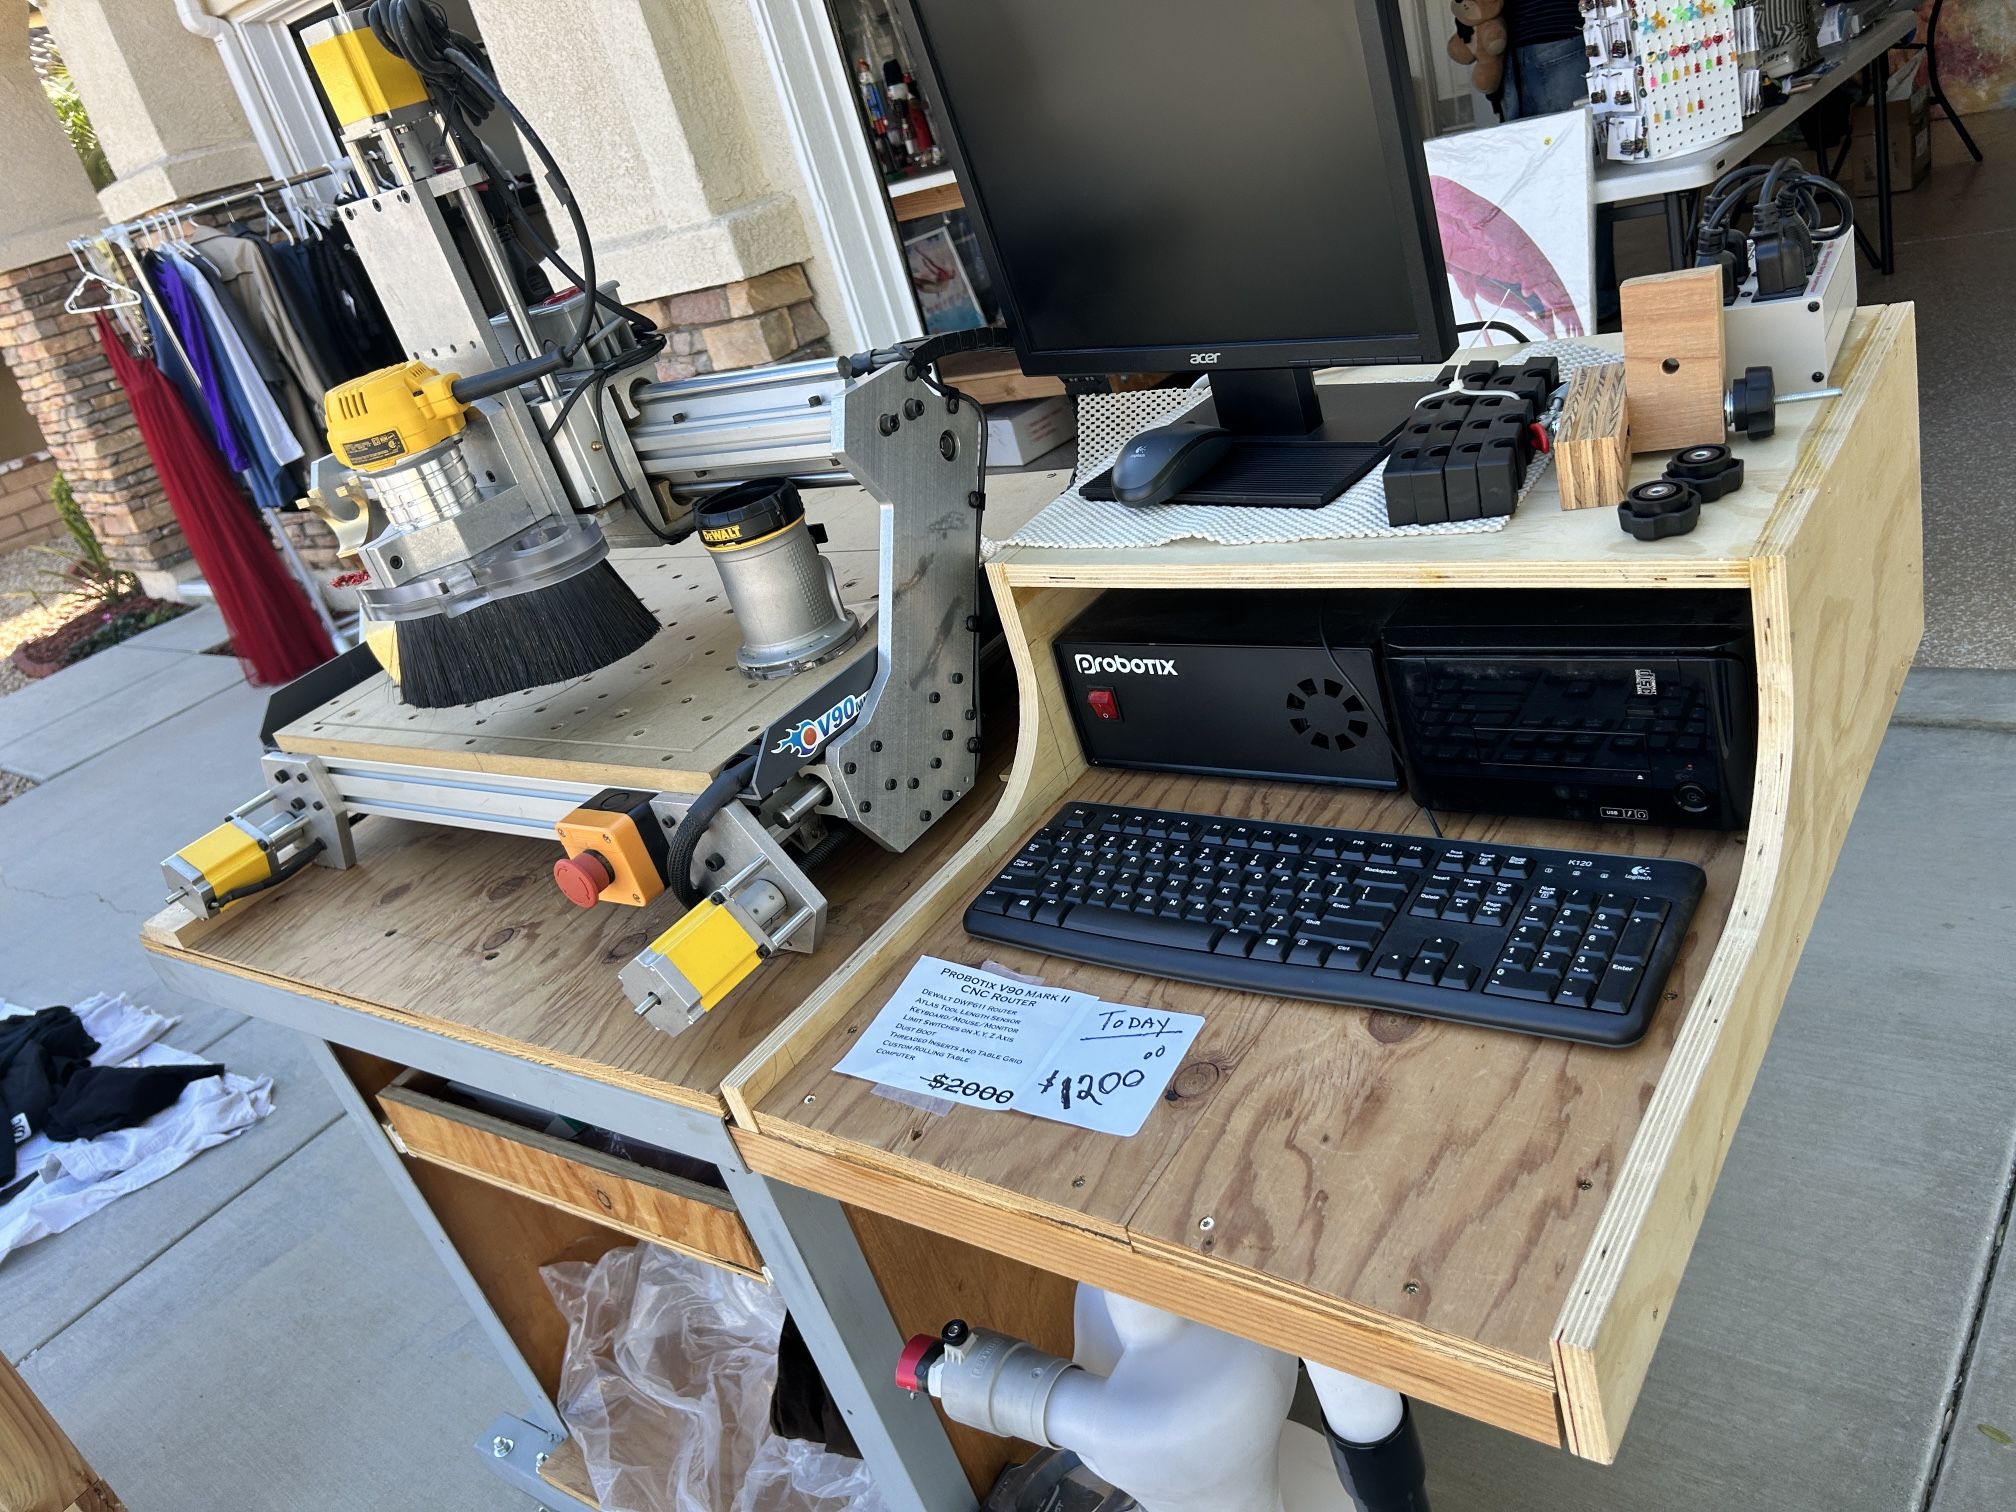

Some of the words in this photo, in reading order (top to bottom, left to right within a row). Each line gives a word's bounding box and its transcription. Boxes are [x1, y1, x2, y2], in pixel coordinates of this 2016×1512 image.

[1190, 353, 1221, 364] acer
[817, 697, 855, 737] V90
[1568, 859, 1593, 867] K120
[1624, 873, 1652, 881] Logitech
[940, 967, 998, 990] PROBOTIX
[999, 984, 1024, 996] V90
[1024, 990, 1060, 1001] MARK
[1060, 995, 1071, 1003] II
[961, 984, 990, 998] CNC
[990, 992, 1038, 1007] ROUTER
[915, 997, 939, 1009] ATLAS
[940, 1004, 959, 1013] TOOL
[960, 1009, 990, 1020] LENGTH
[990, 1015, 1022, 1024] SENSOR
[921, 988, 953, 1001] DEWALT
[953, 997, 986, 1010] DWP611
[987, 1005, 1018, 1015] ROUTER
[895, 1022, 916, 1032] DUST
[916, 1028, 937, 1036] BOOT
[903, 1014, 923, 1023] LIMIT
[923, 1019, 960, 1031] SWITCHES
[876, 1048, 916, 1061] COMPUTER
[882, 1039, 913, 1050] CUSTOM
[913, 1045, 945, 1057] ROLLING
[946, 1053, 971, 1063] TABLE
[890, 1031, 928, 1043] THREADED
[928, 1039, 959, 1051] INSERTS
[960, 1047, 977, 1055] AND
[978, 1050, 1002, 1060] TABLE
[1002, 1055, 1023, 1065] GRID
[926, 1072, 1015, 1104] $2000
[1038, 1069, 1145, 1110] $1200
